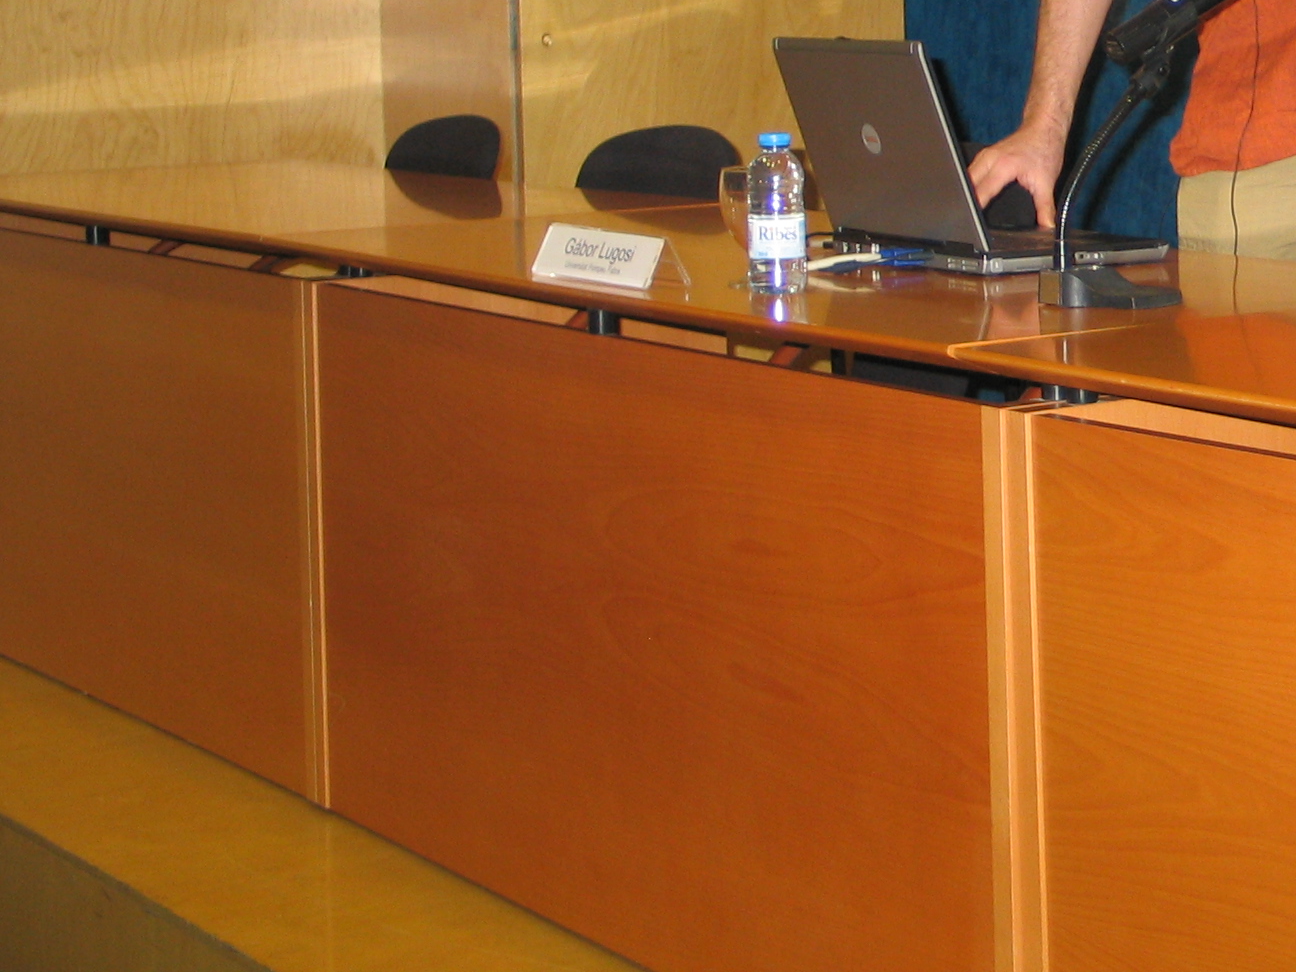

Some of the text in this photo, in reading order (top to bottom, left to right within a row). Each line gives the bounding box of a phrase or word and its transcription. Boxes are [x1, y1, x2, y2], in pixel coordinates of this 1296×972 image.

[758, 225, 798, 241] Ribes
[565, 237, 636, 264] Gábor Lugosi
